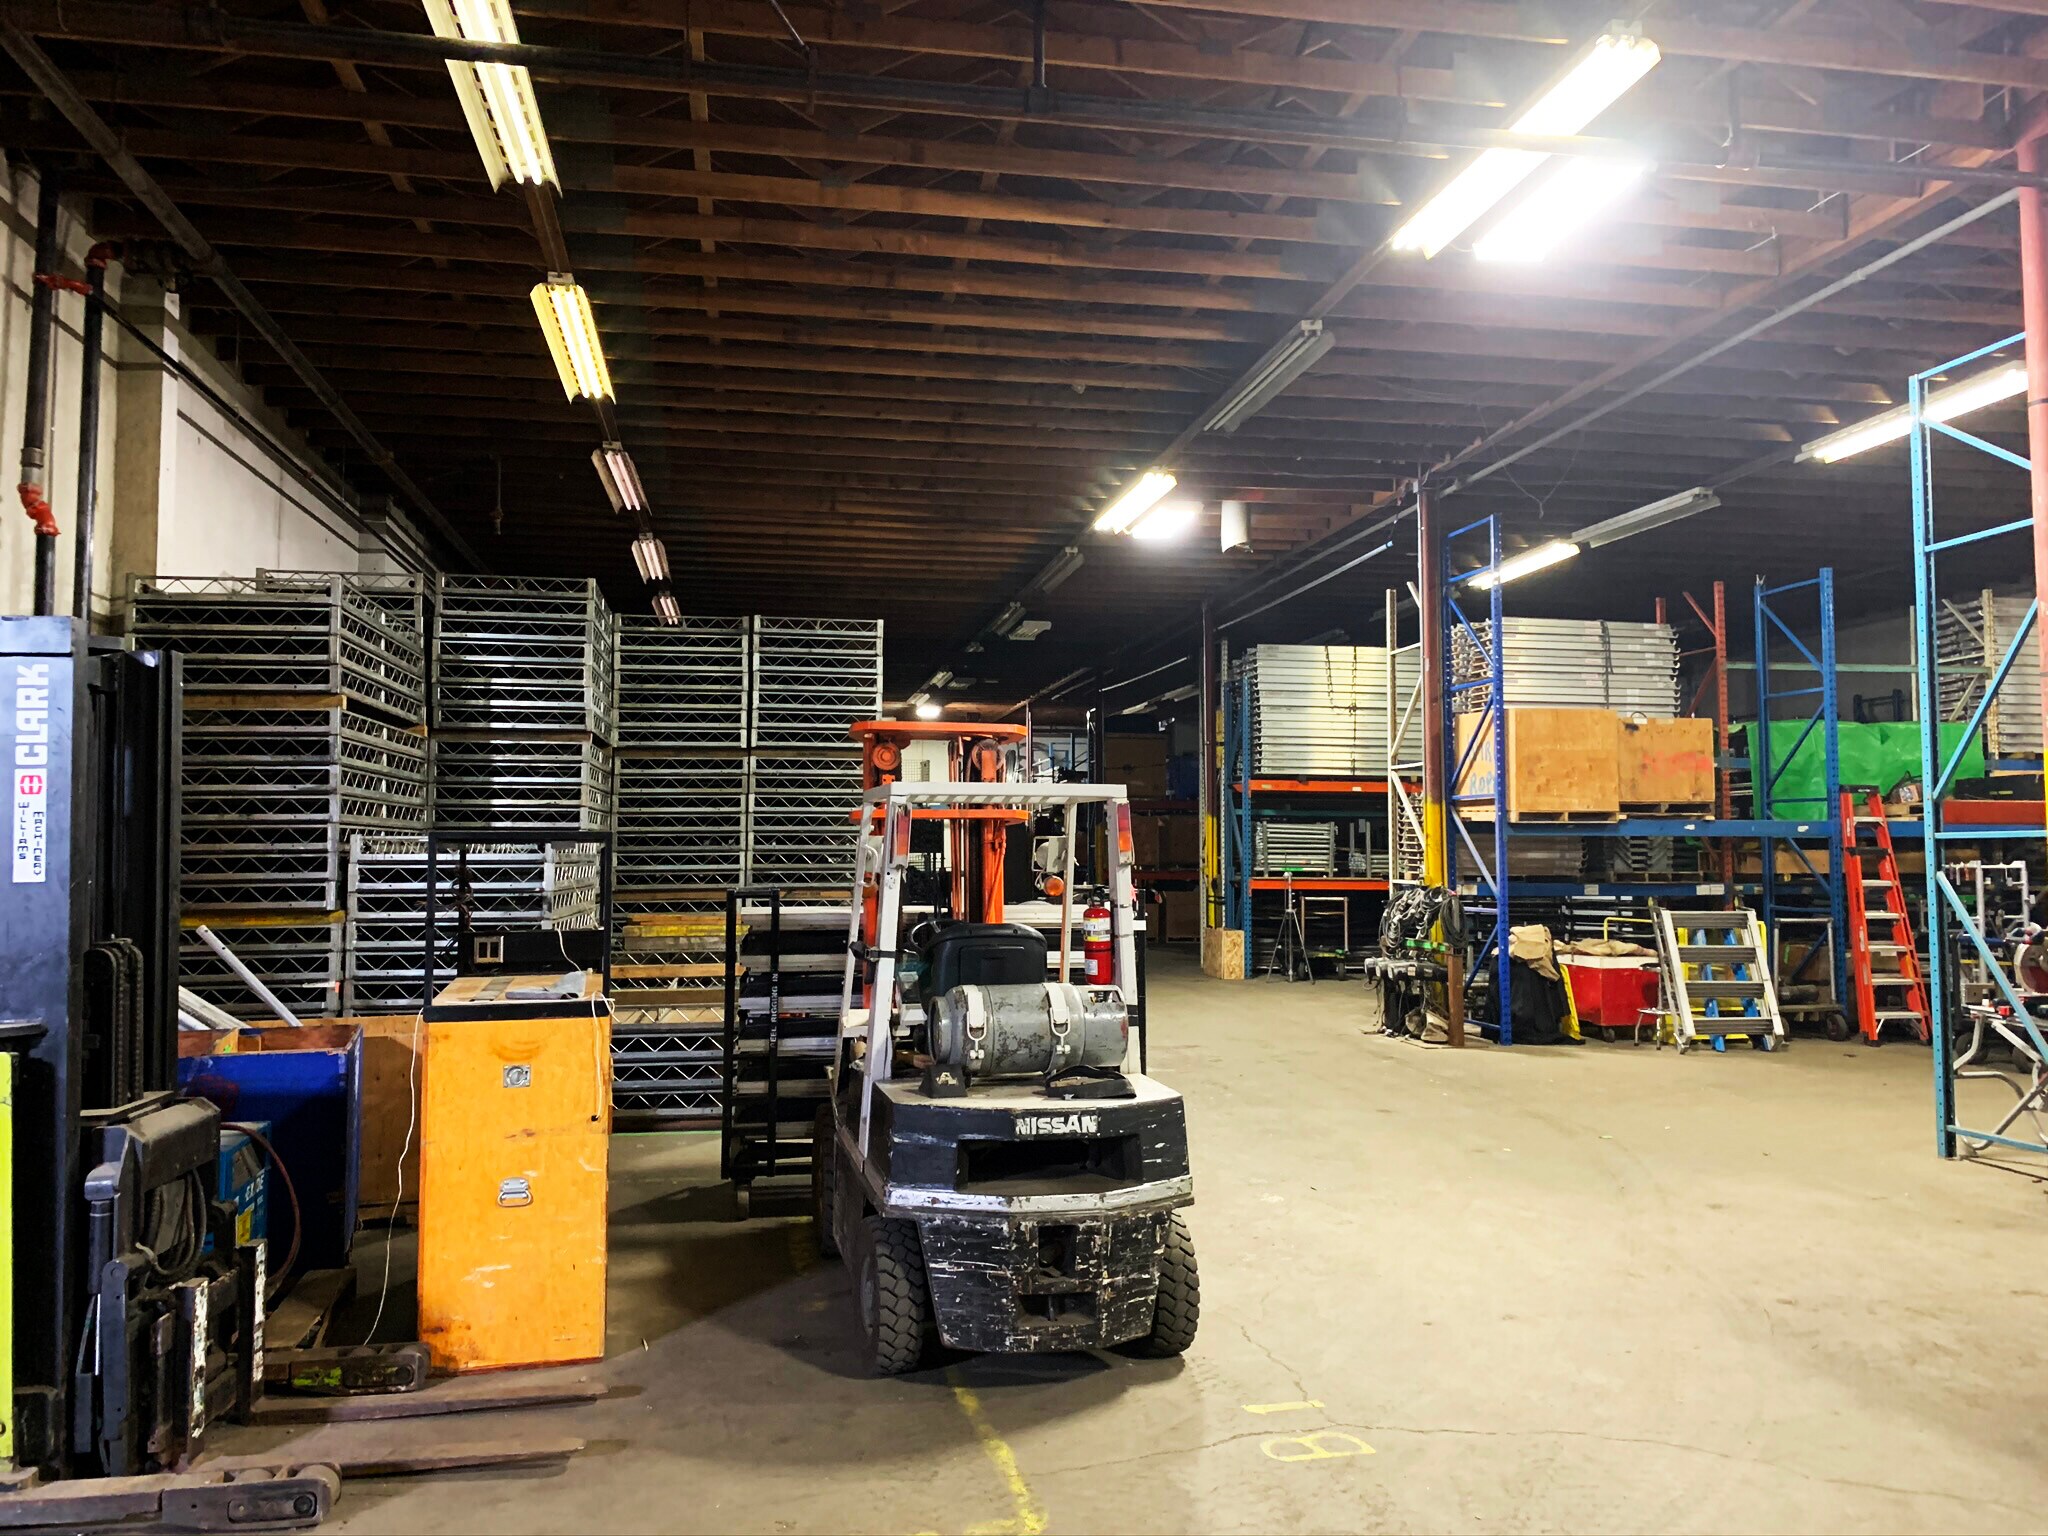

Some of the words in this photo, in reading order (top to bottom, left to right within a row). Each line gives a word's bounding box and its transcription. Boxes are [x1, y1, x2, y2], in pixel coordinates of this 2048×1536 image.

[15, 663, 50, 766] CLARK
[1469, 770, 1494, 796] ROP
[770, 985, 779, 1023] RIGGING
[1015, 1114, 1099, 1136] NISSAN
